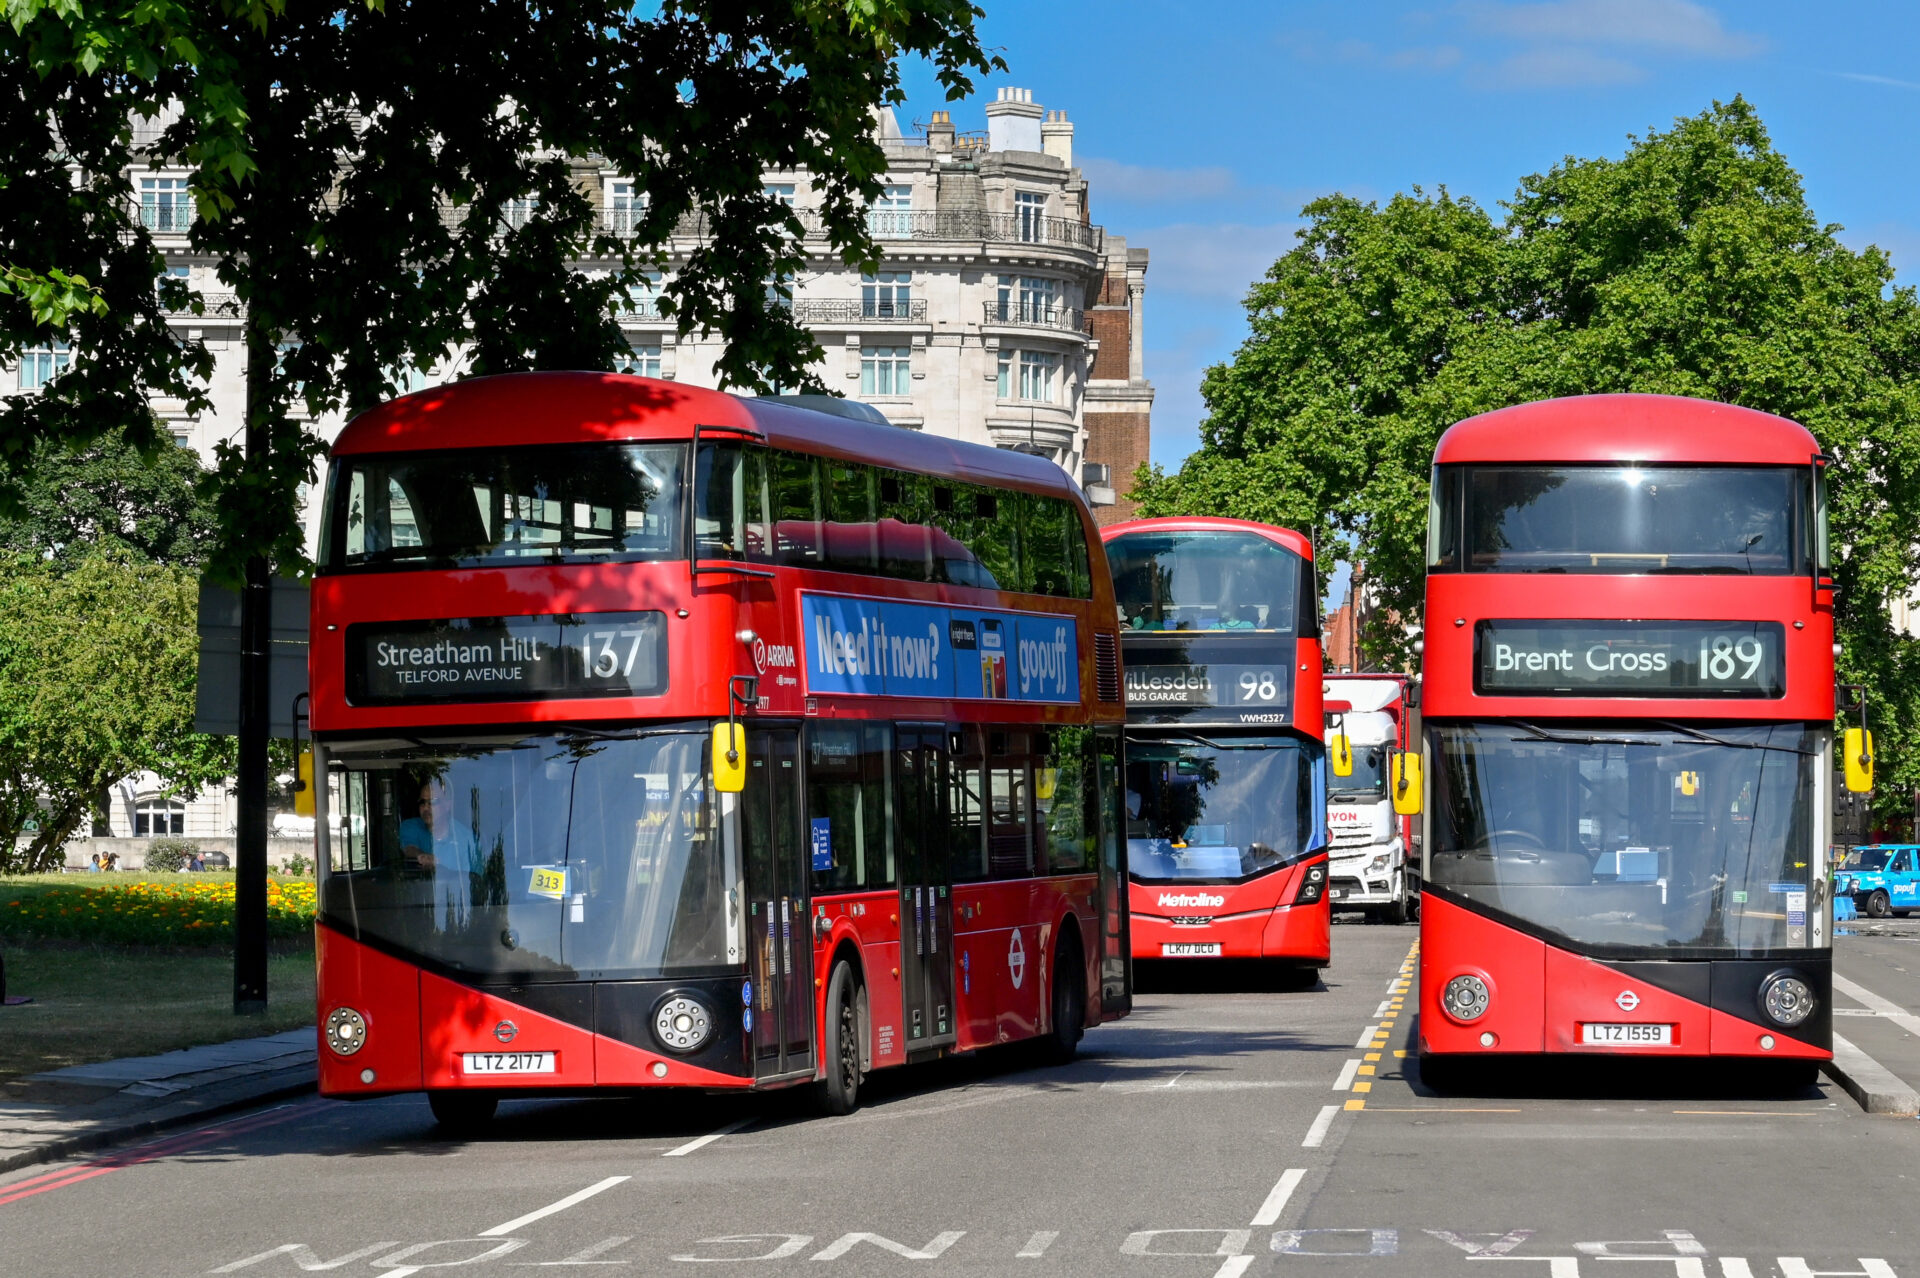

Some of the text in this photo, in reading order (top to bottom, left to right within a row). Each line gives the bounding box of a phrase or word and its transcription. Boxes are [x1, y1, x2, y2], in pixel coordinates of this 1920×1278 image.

[377, 636, 541, 667] Streatham Hill
[583, 630, 644, 678] 137
[767, 645, 796, 667] ARRIVA
[816, 615, 940, 680] Need it now?
[1019, 626, 1067, 694] gopuff
[1495, 644, 1667, 671] Brent Cross
[1700, 636, 1762, 680] 189
[396, 667, 523, 684] TELFORD AVENUE
[1239, 671, 1276, 701] 98
[1128, 692, 1188, 701] BUS GARAGE
[1240, 713, 1285, 723] VWH2327
[535, 874, 560, 890] 313
[1893, 882, 1917, 895] gopuff
[1157, 892, 1225, 907] Metroline
[1169, 944, 1214, 954] LK17 DCO
[1593, 1026, 1662, 1041] LTZ 1559
[473, 1054, 544, 1070] LTZ 2177
